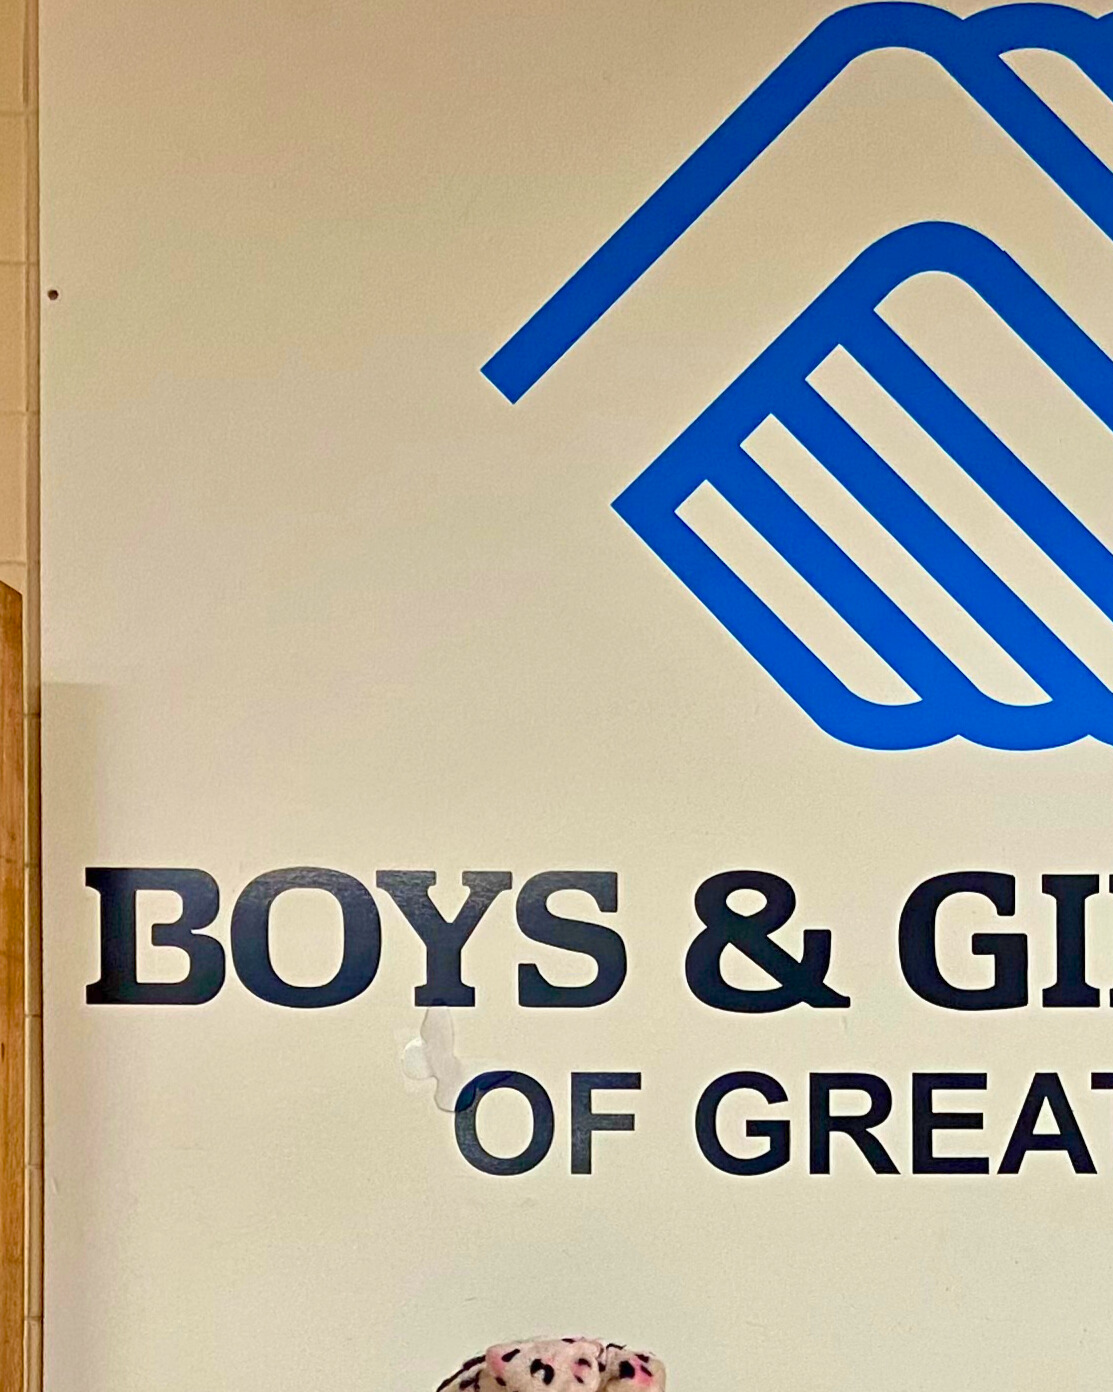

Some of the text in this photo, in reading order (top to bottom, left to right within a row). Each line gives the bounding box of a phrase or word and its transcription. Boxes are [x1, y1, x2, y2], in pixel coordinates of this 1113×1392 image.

[84, 866, 628, 1010] BOYS
[684, 869, 851, 1014] &
[454, 1070, 642, 1177] OF
